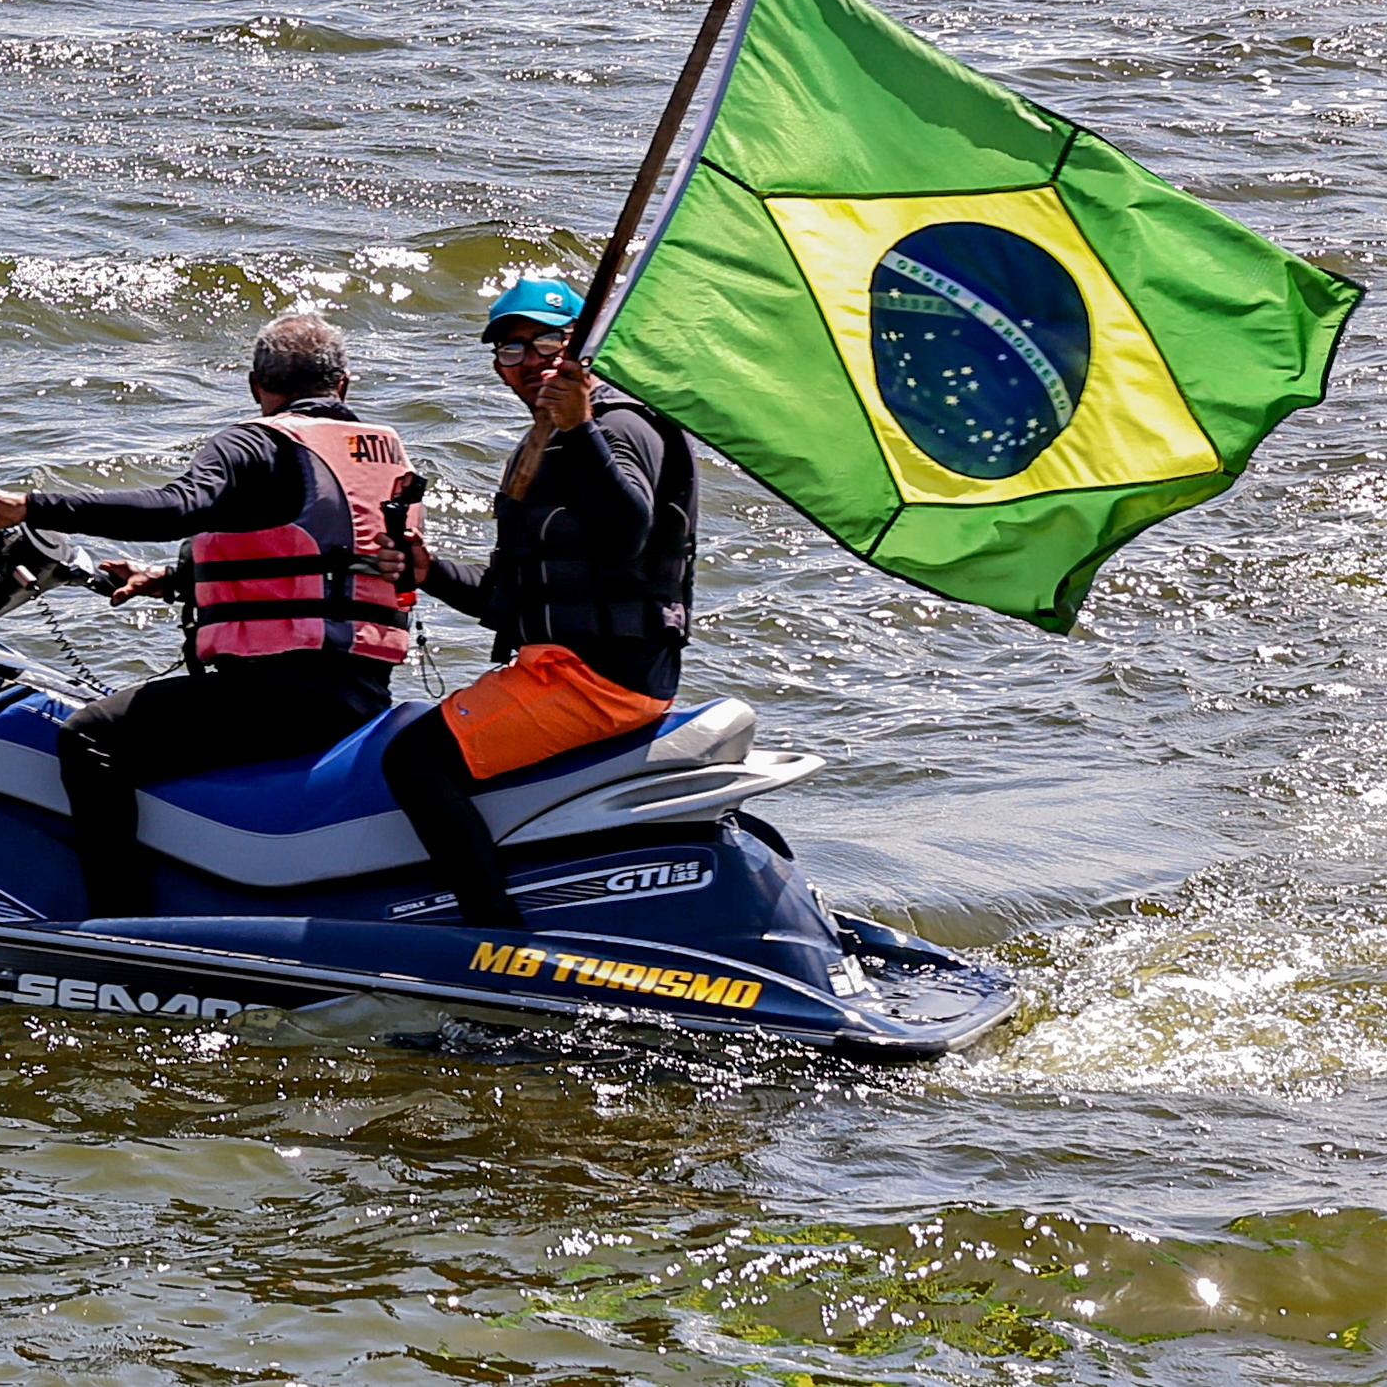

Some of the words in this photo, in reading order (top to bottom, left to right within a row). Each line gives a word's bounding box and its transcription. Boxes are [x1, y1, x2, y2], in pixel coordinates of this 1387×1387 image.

[895, 259, 961, 298] ORDEM
[970, 301, 985, 315] E
[992, 317, 1068, 411] PROGRESSO
[606, 866, 671, 891] GTI
[672, 860, 700, 873] SE
[469, 942, 548, 978] MB
[553, 953, 764, 1010] TURISMO
